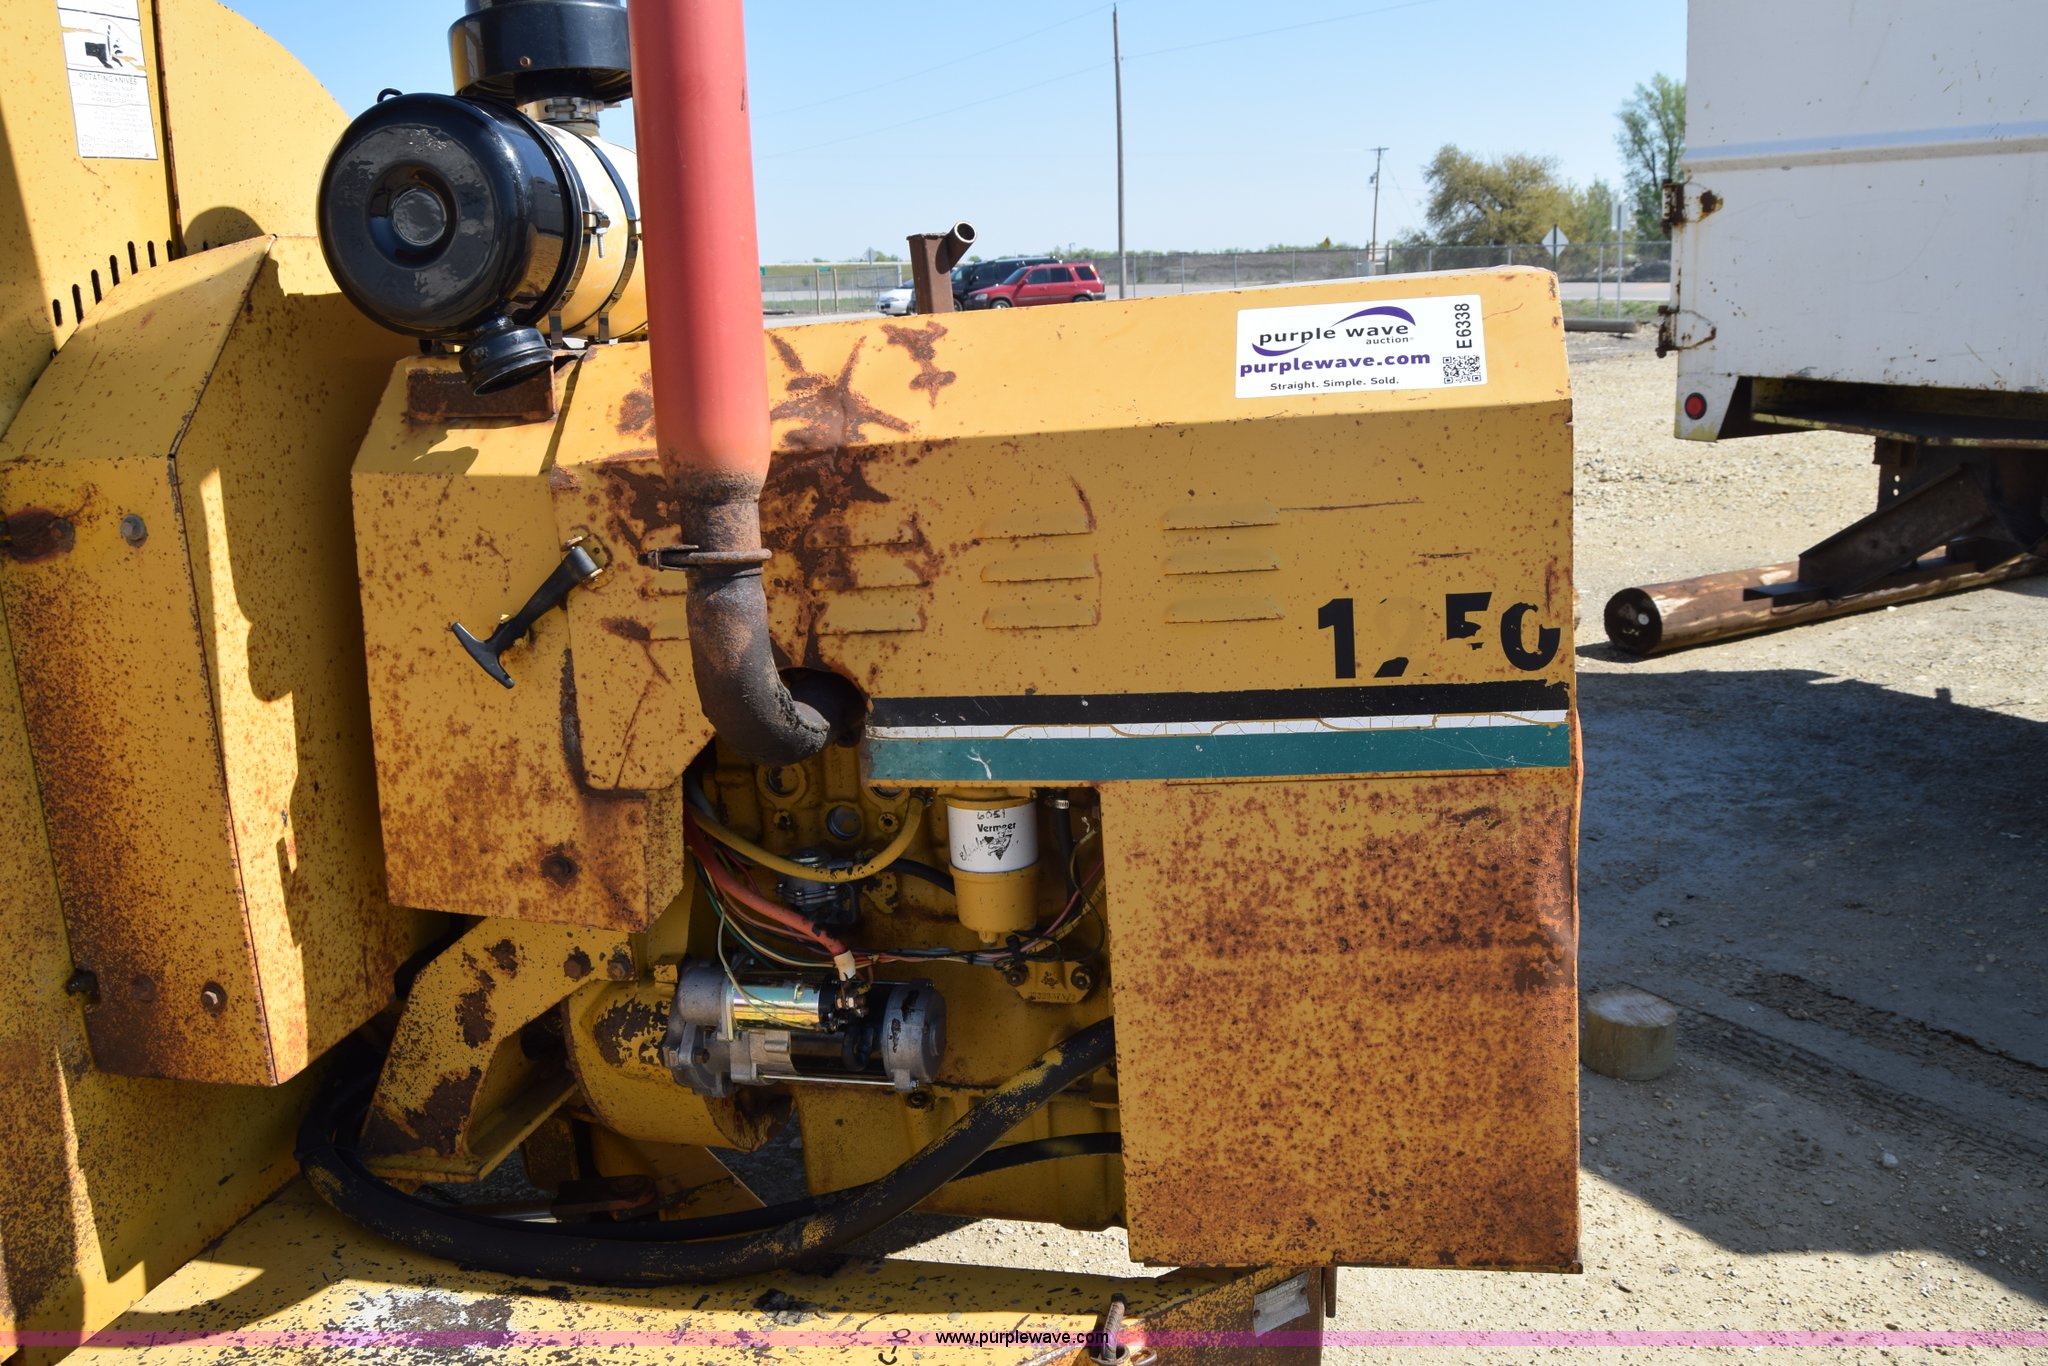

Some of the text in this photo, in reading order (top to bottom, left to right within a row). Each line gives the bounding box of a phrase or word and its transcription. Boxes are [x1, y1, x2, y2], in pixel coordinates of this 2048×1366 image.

[1454, 303, 1473, 349] E6338
[1259, 325, 1409, 346] purple wave
[1365, 336, 1409, 345] auction
[1240, 353, 1431, 377] purplewave.com
[1270, 376, 1399, 391] Straight. Simple. Sold.
[977, 822, 1017, 833] Vermeer
